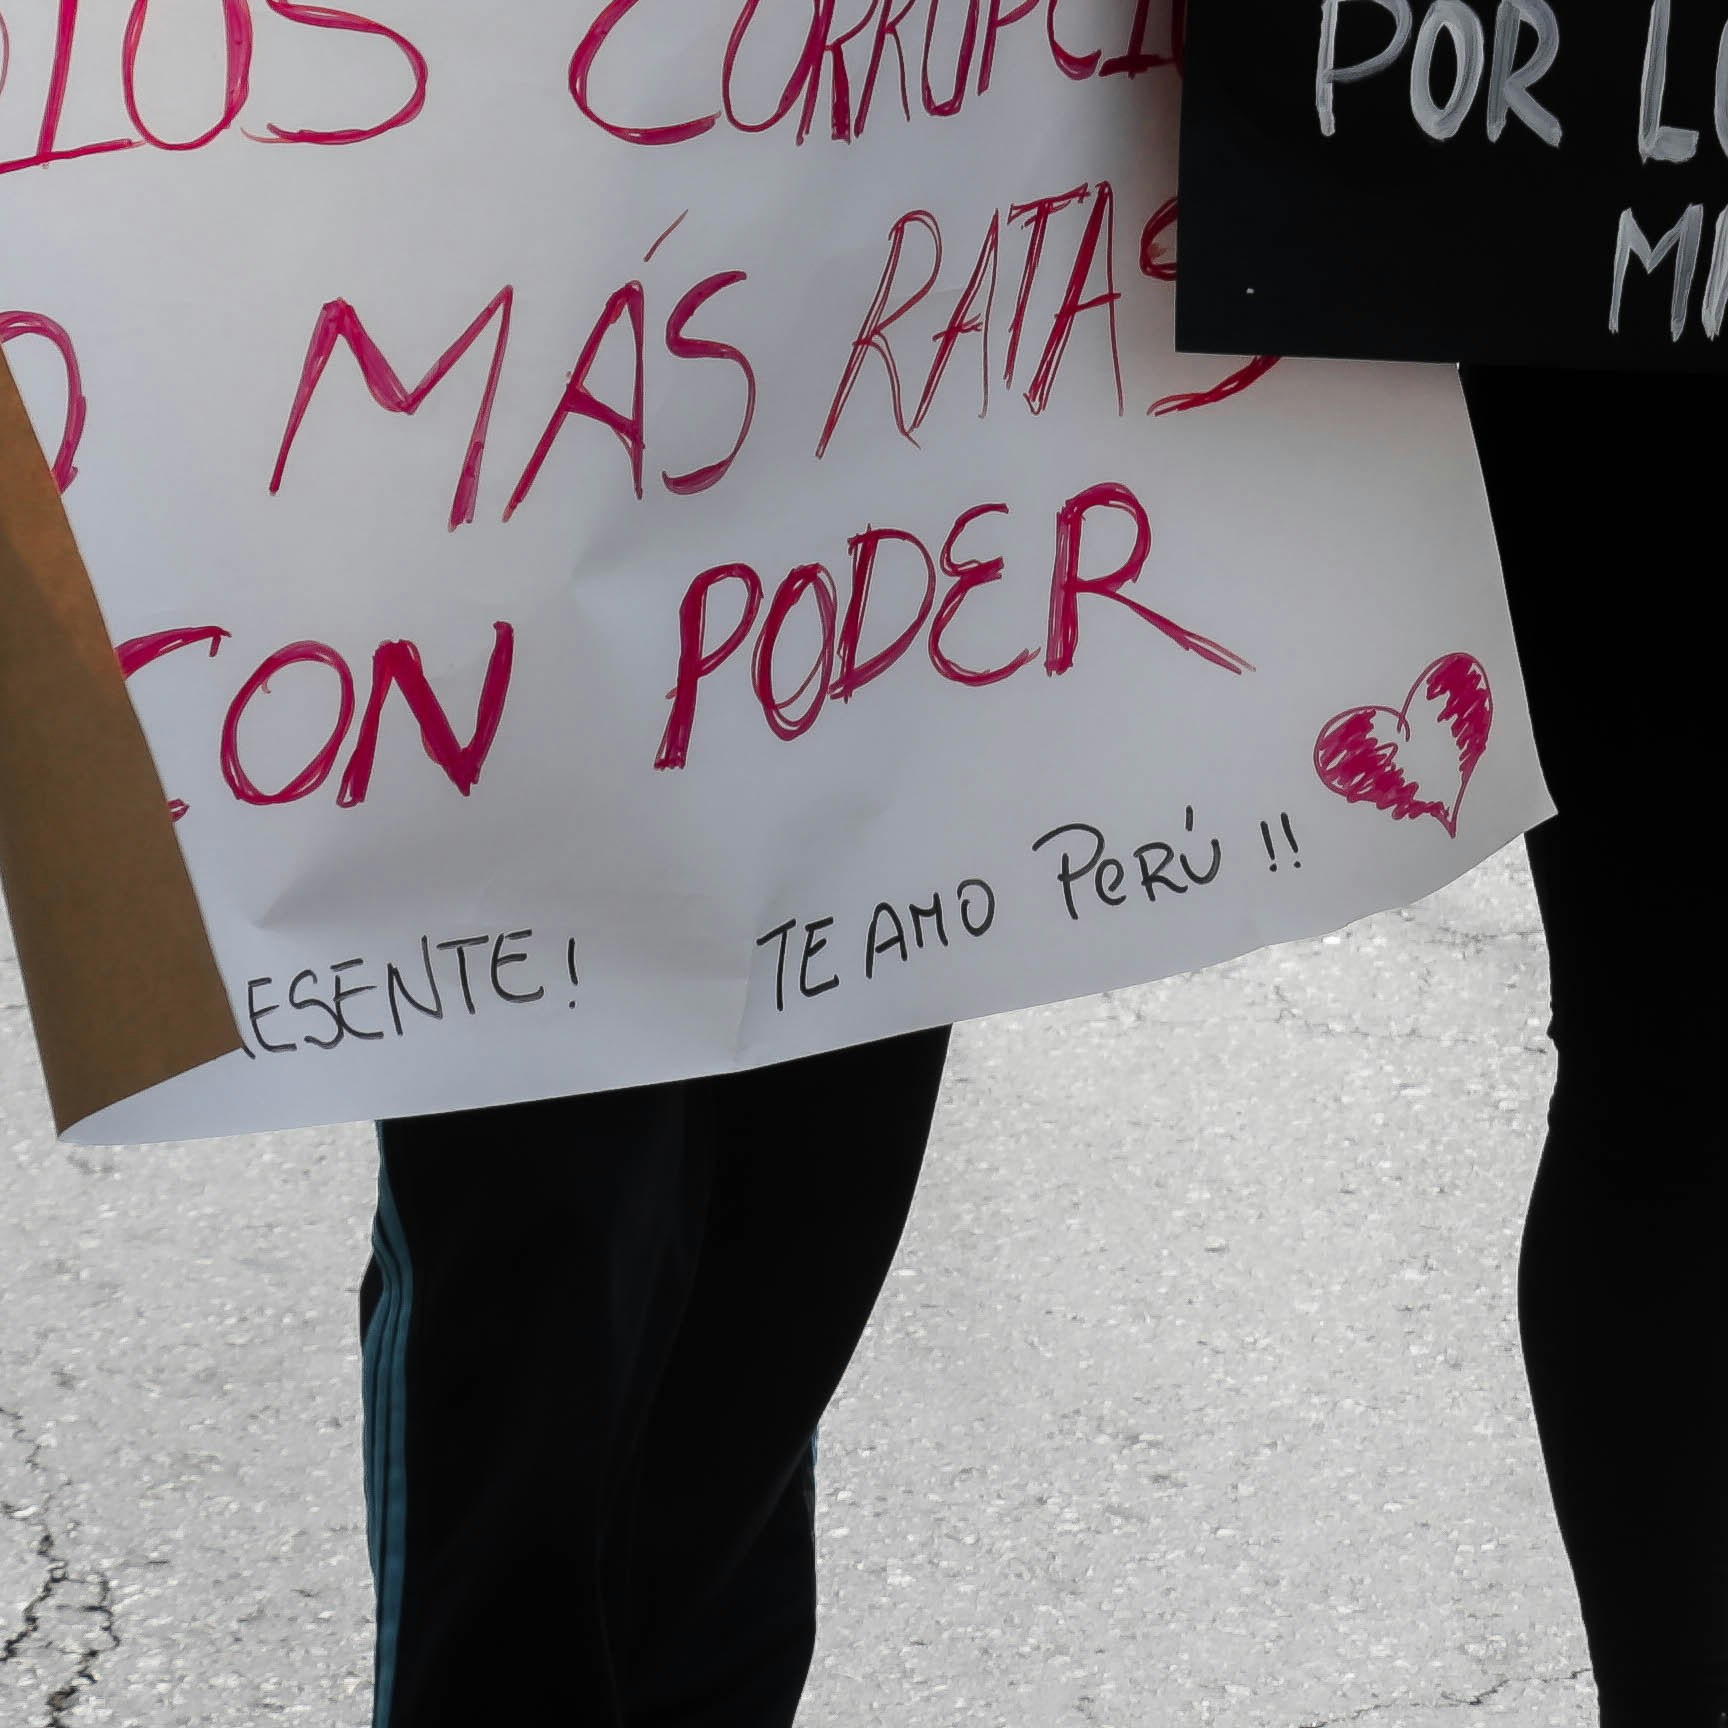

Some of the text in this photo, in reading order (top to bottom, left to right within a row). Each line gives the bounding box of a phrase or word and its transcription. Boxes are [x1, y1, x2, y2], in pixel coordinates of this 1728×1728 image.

[270, 210, 756, 529] MÁS
[655, 481, 1255, 769] PODER
[240, 930, 580, 1060] ESENTE!
[755, 915, 841, 1013] TE
[865, 878, 996, 980] AMO
